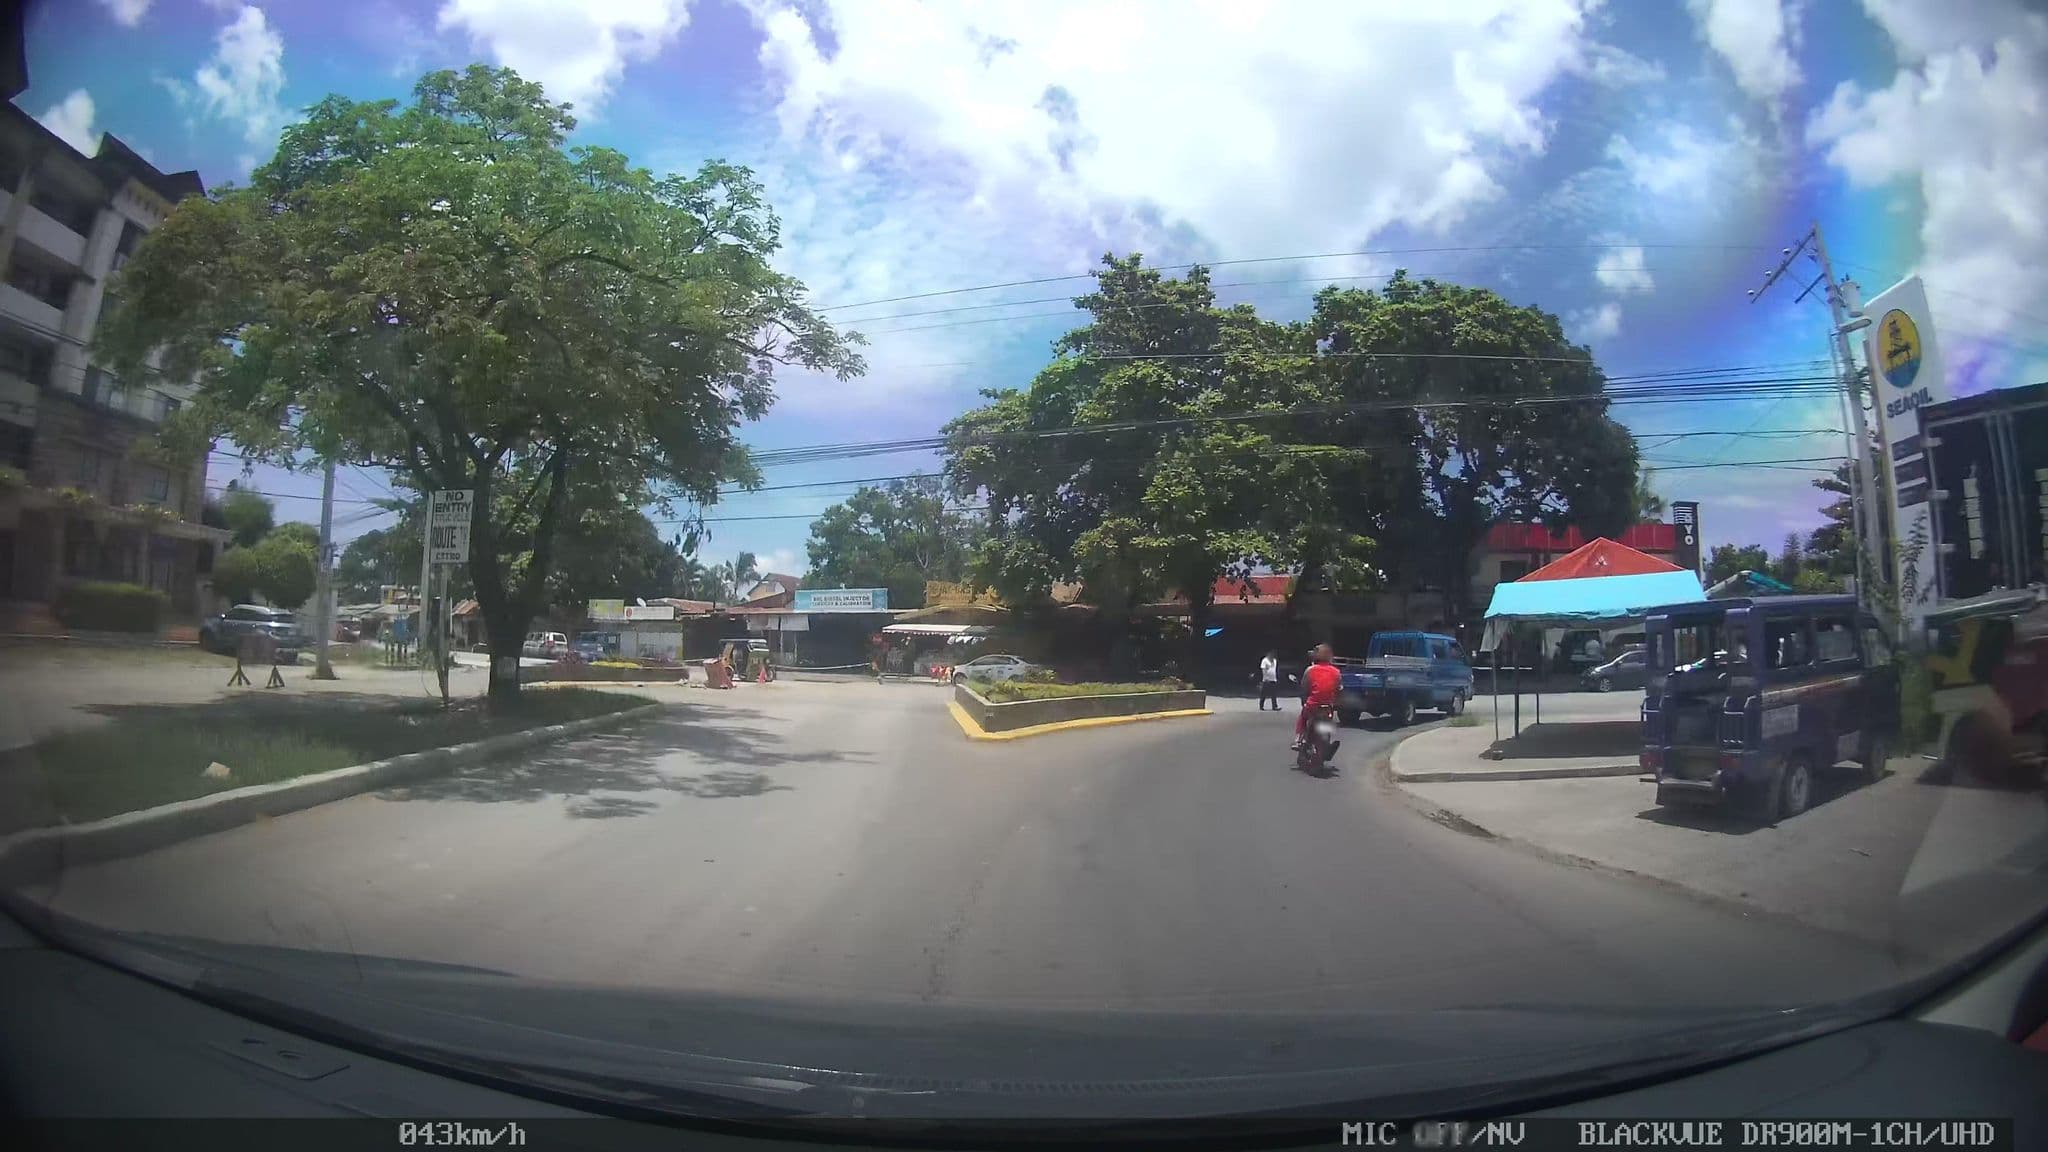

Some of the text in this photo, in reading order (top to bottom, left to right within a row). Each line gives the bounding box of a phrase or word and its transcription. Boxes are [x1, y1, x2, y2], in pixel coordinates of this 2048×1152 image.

[1887, 387, 1933, 418] SEAOIL
[446, 491, 464, 501] NO
[435, 502, 471, 513] ENTRY
